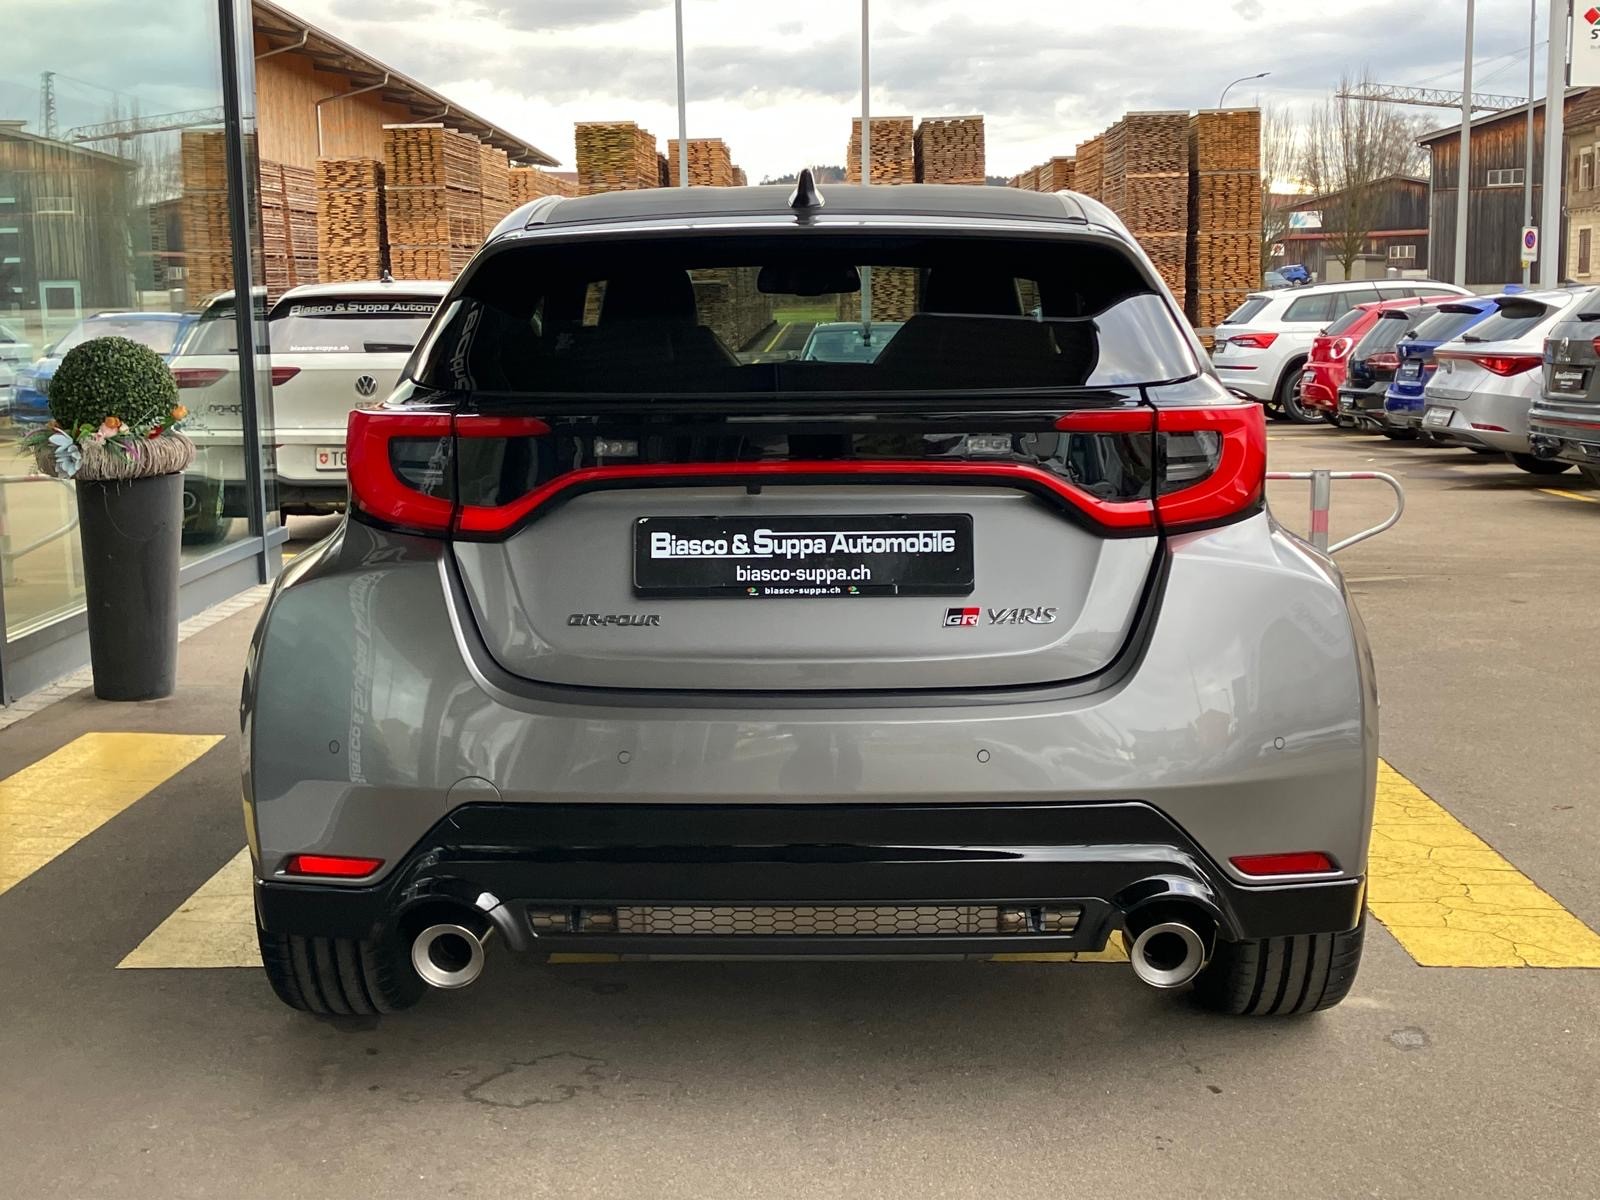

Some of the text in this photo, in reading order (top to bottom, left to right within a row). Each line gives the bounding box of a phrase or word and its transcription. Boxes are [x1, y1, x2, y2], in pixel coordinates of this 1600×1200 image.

[289, 304, 333, 316] Biasco
[335, 303, 346, 311] &
[347, 301, 390, 313] Suppa
[651, 529, 956, 559] Biasco & Suppa Automobile
[736, 564, 871, 584] biasco-suppa.ch
[764, 587, 841, 595] biasco-suppa.ch
[567, 613, 661, 627] GR-FOUR
[943, 606, 1059, 627] GR YARIS
